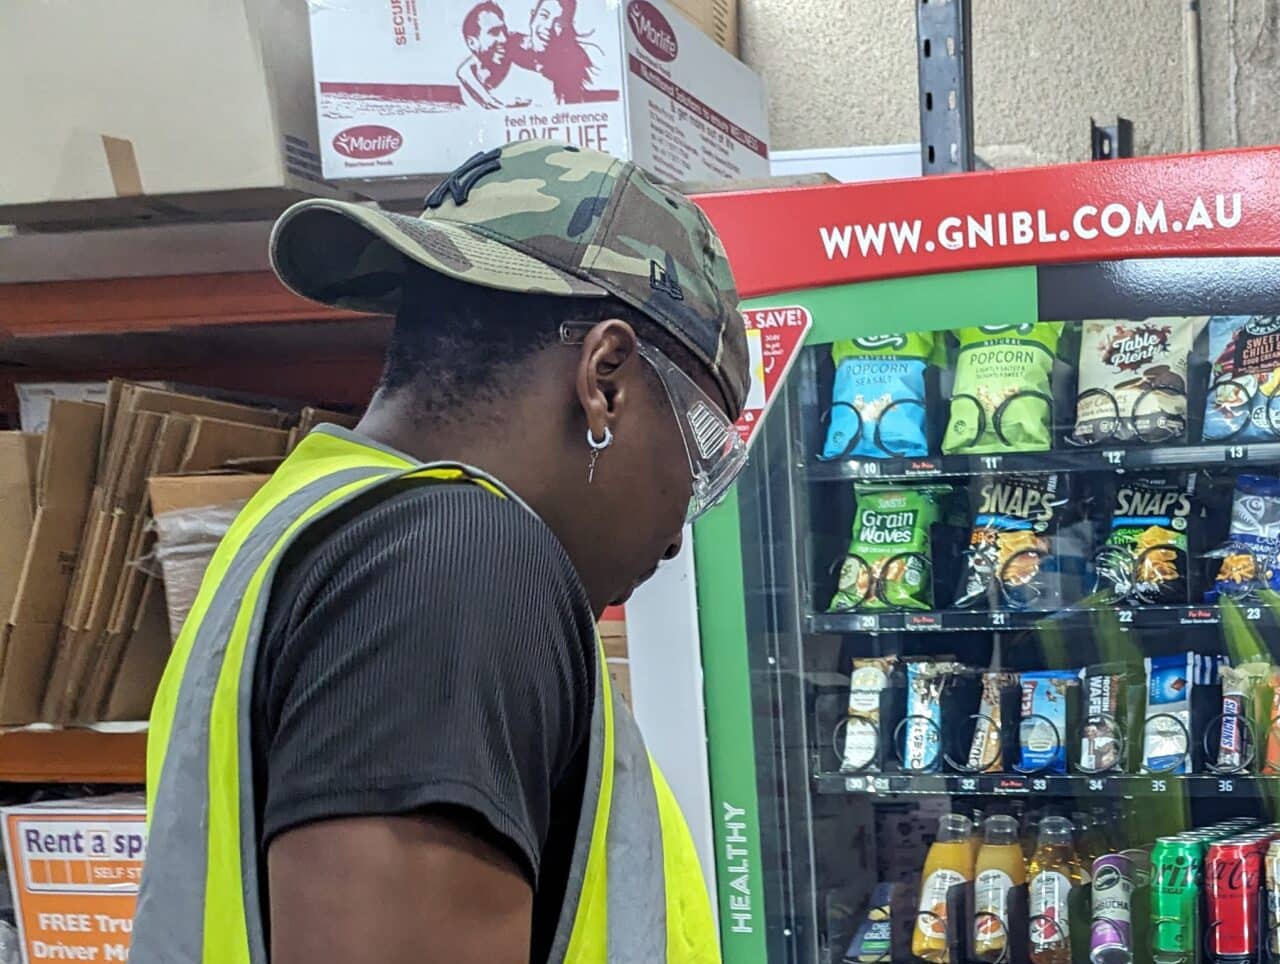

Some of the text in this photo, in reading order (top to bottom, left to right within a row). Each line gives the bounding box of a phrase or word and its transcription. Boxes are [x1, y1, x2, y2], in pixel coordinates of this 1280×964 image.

[640, 15, 676, 58] Morlife
[504, 112, 608, 127] feel the difference
[350, 132, 400, 152] Morlife
[819, 193, 1243, 261] WWW.GNIBL.COM.AU
[755, 309, 802, 329] SAVE!
[1114, 332, 1160, 353] Table
[1246, 333, 1280, 350] SWEET
[969, 350, 1035, 366] POPCORN
[1110, 344, 1166, 367] Plenty
[1242, 343, 1274, 360] CHILLI
[847, 363, 908, 376] POPCORN
[1108, 452, 1121, 464] 12
[1230, 447, 1244, 458] 13
[863, 462, 876, 474] 10
[985, 459, 997, 469] 11
[978, 484, 1056, 521] SNAPS
[1113, 488, 1191, 516] SNAPS
[862, 510, 914, 529] Grain
[860, 527, 913, 544] Waves
[992, 614, 1004, 624] 21
[1119, 611, 1133, 622] 22
[1246, 608, 1261, 620] 23
[1088, 675, 1103, 728] WAFER
[1221, 698, 1239, 751] SNICKRS
[962, 779, 976, 790] 32
[1033, 779, 1047, 790] 33
[1089, 779, 1103, 790] 34
[1151, 780, 1166, 792] 35
[1218, 781, 1233, 792] 36
[26, 829, 146, 859] Rent a sp
[94, 866, 125, 879] SELF
[722, 801, 753, 933] HEALTHY
[39, 913, 92, 933] FREE
[32, 940, 99, 962] Driver
